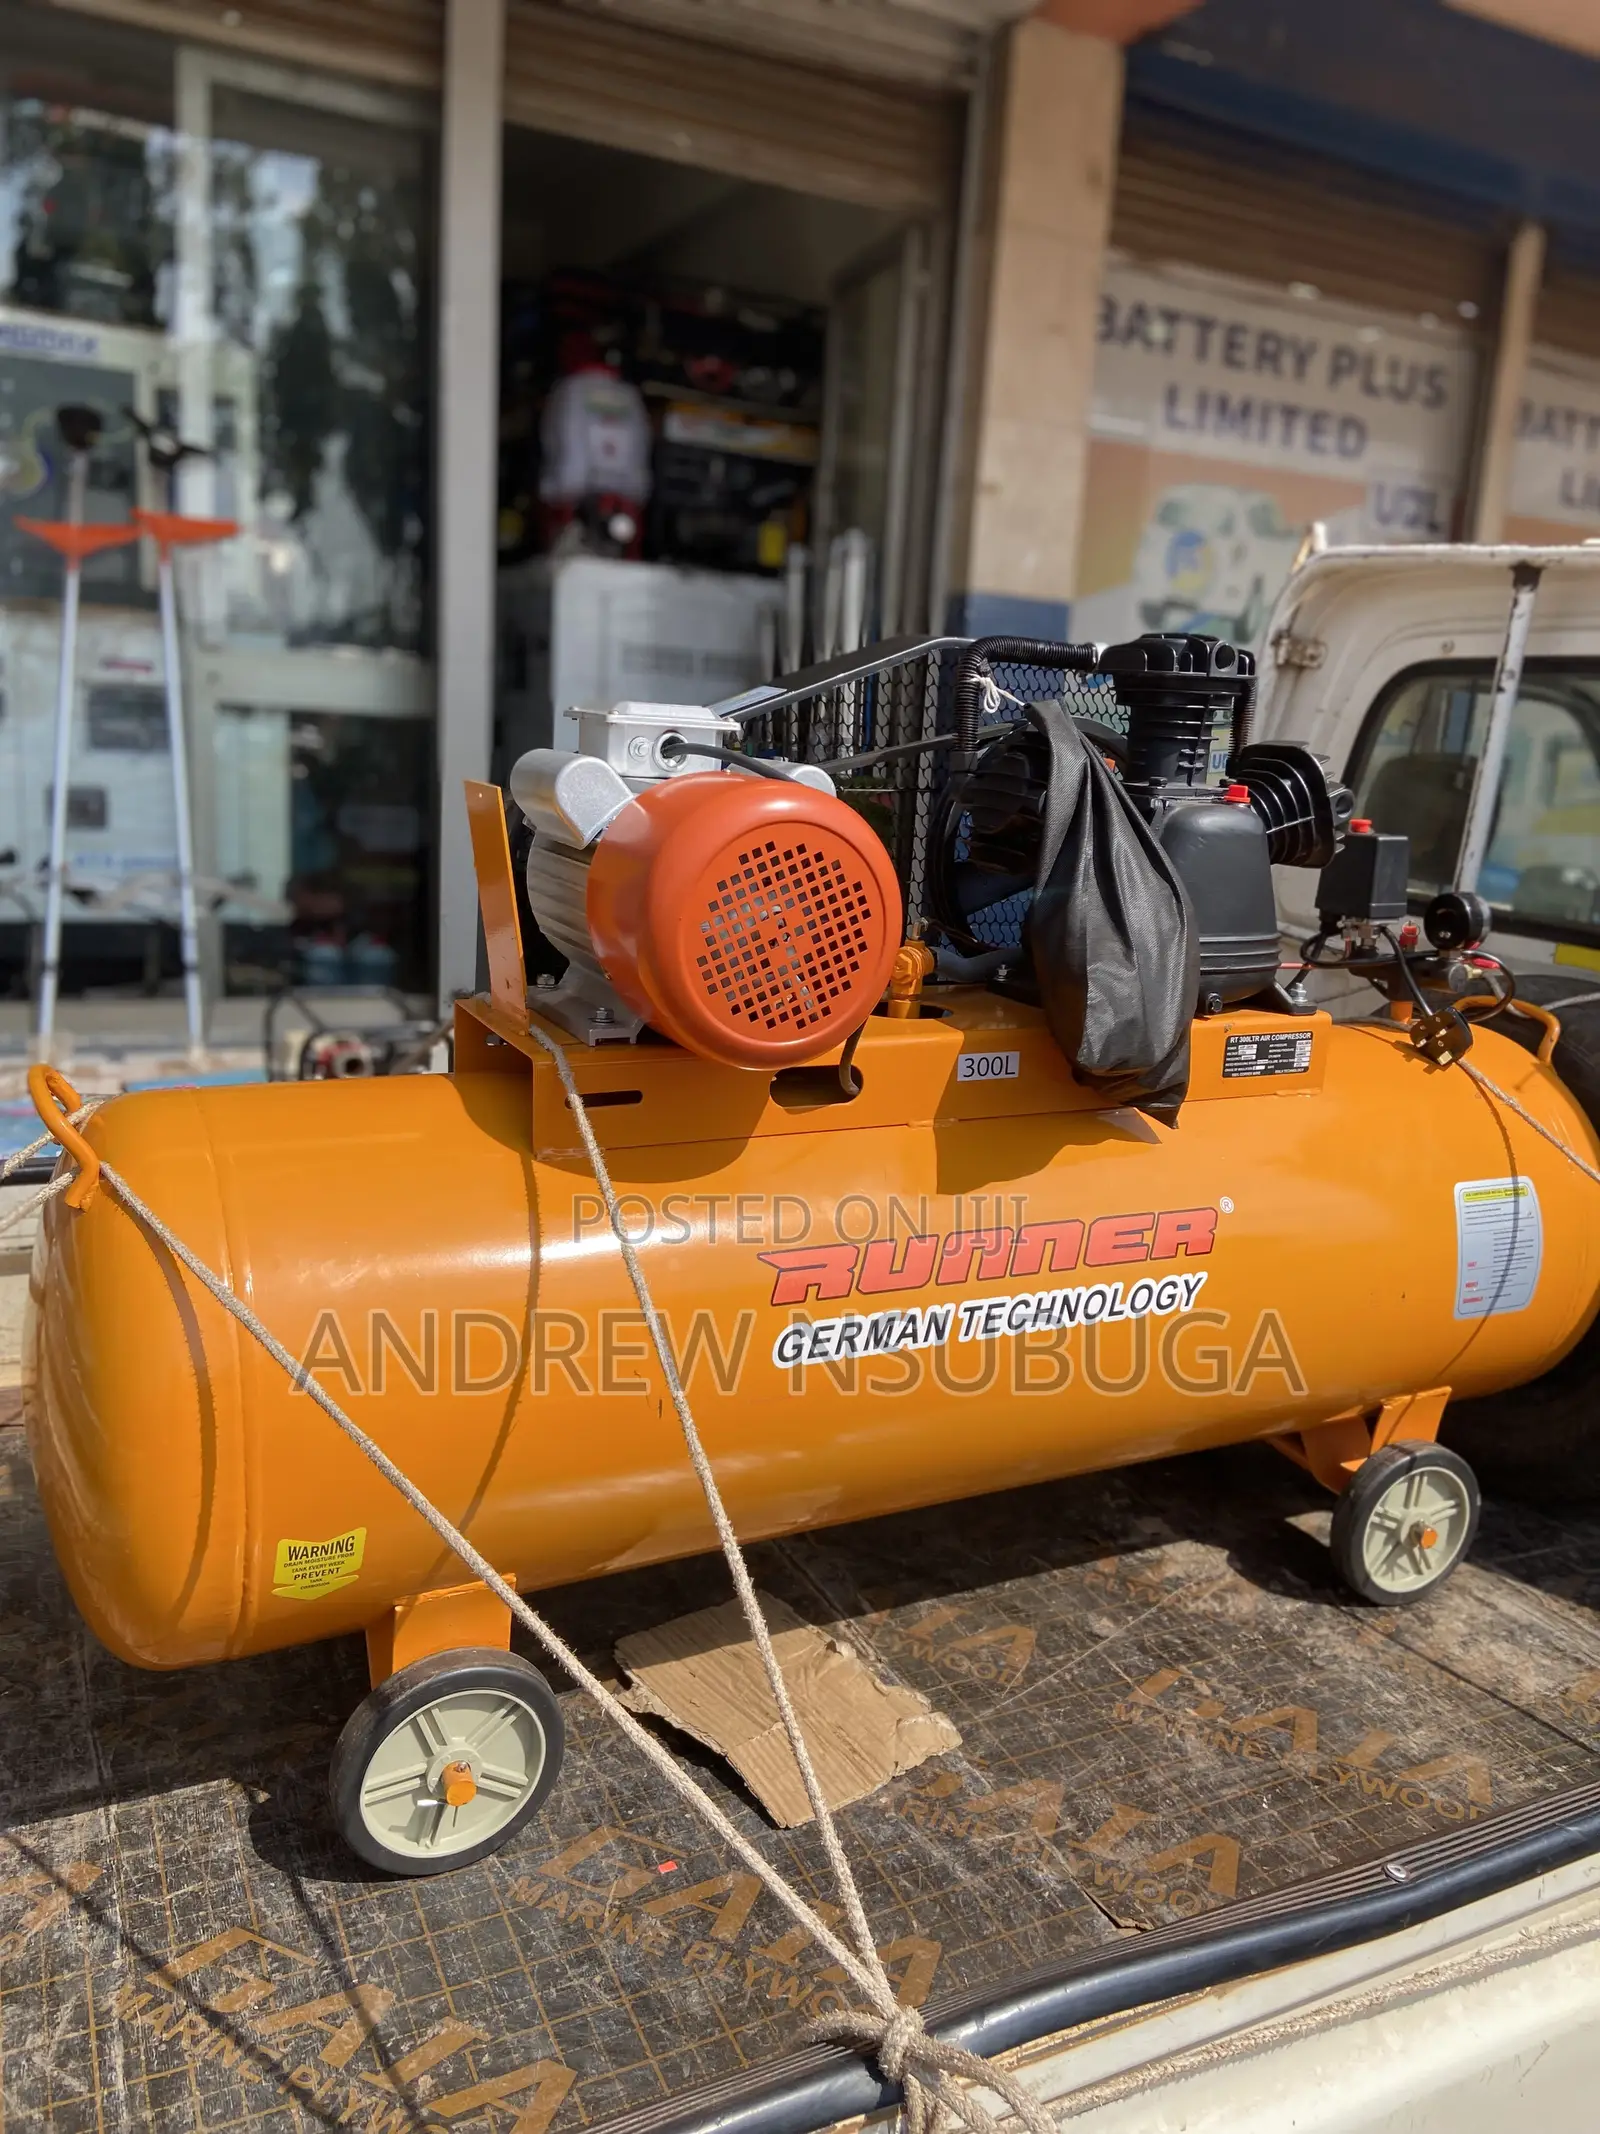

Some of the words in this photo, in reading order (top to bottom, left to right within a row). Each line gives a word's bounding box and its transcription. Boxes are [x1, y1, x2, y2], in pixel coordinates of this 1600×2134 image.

[1097, 293, 1316, 386] BATTERY
[1326, 344, 1450, 411] PLUS
[1163, 382, 1368, 460] LIMITED
[1271, 1032, 1312, 1041] COMPRESSOR
[963, 1055, 1016, 1078] 300L
[757, 1206, 1218, 1306] RUNNER
[776, 1306, 951, 1363] GERMAN
[962, 1277, 1203, 1339] TECHNOLOGY
[288, 1535, 355, 1561] WARNING
[304, 1555, 336, 1565] MOISTURE
[337, 1552, 355, 1560] FROM
[293, 1567, 341, 1580] PREVENT
[308, 1563, 327, 1571] EVERY
